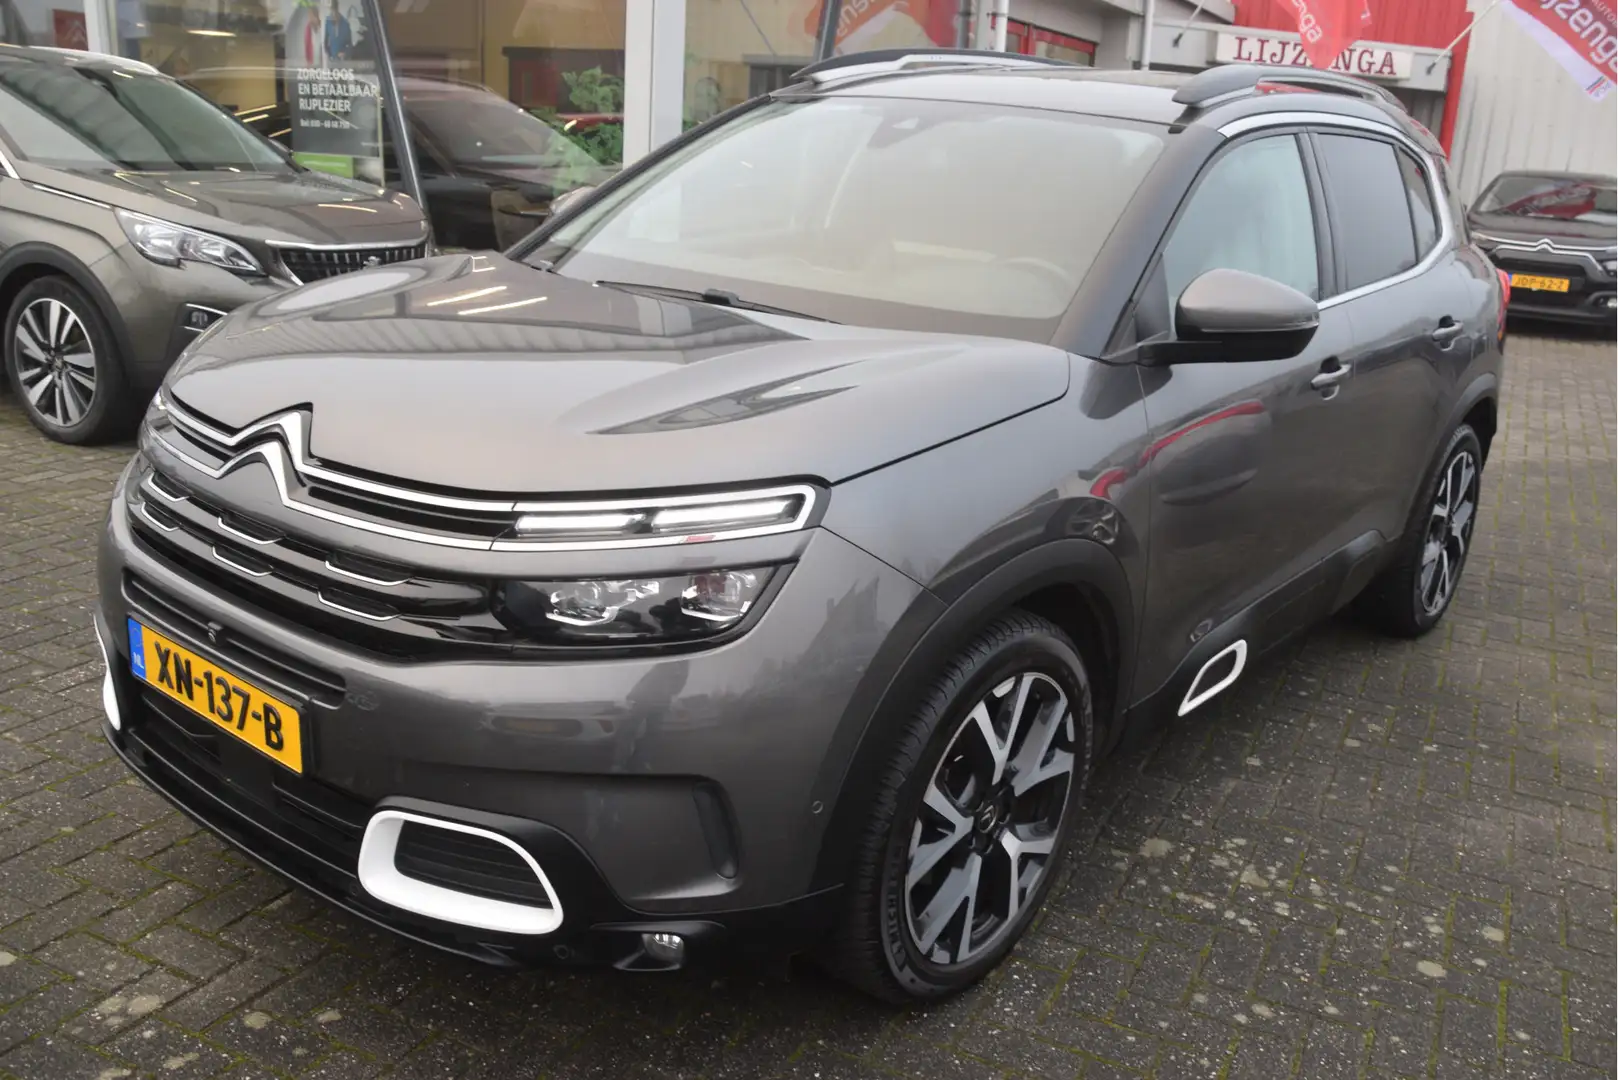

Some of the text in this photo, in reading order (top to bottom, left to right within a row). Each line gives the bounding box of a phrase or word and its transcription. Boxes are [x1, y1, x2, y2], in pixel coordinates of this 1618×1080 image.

[1233, 36, 1397, 76] LIJZNGA
[297, 68, 354, 81] ZORGELOOS
[298, 83, 379, 97] EN BETAALBAAR
[299, 98, 351, 112] RIJPLEZIER
[133, 652, 145, 670] NL
[154, 641, 284, 751] XN-137-B
